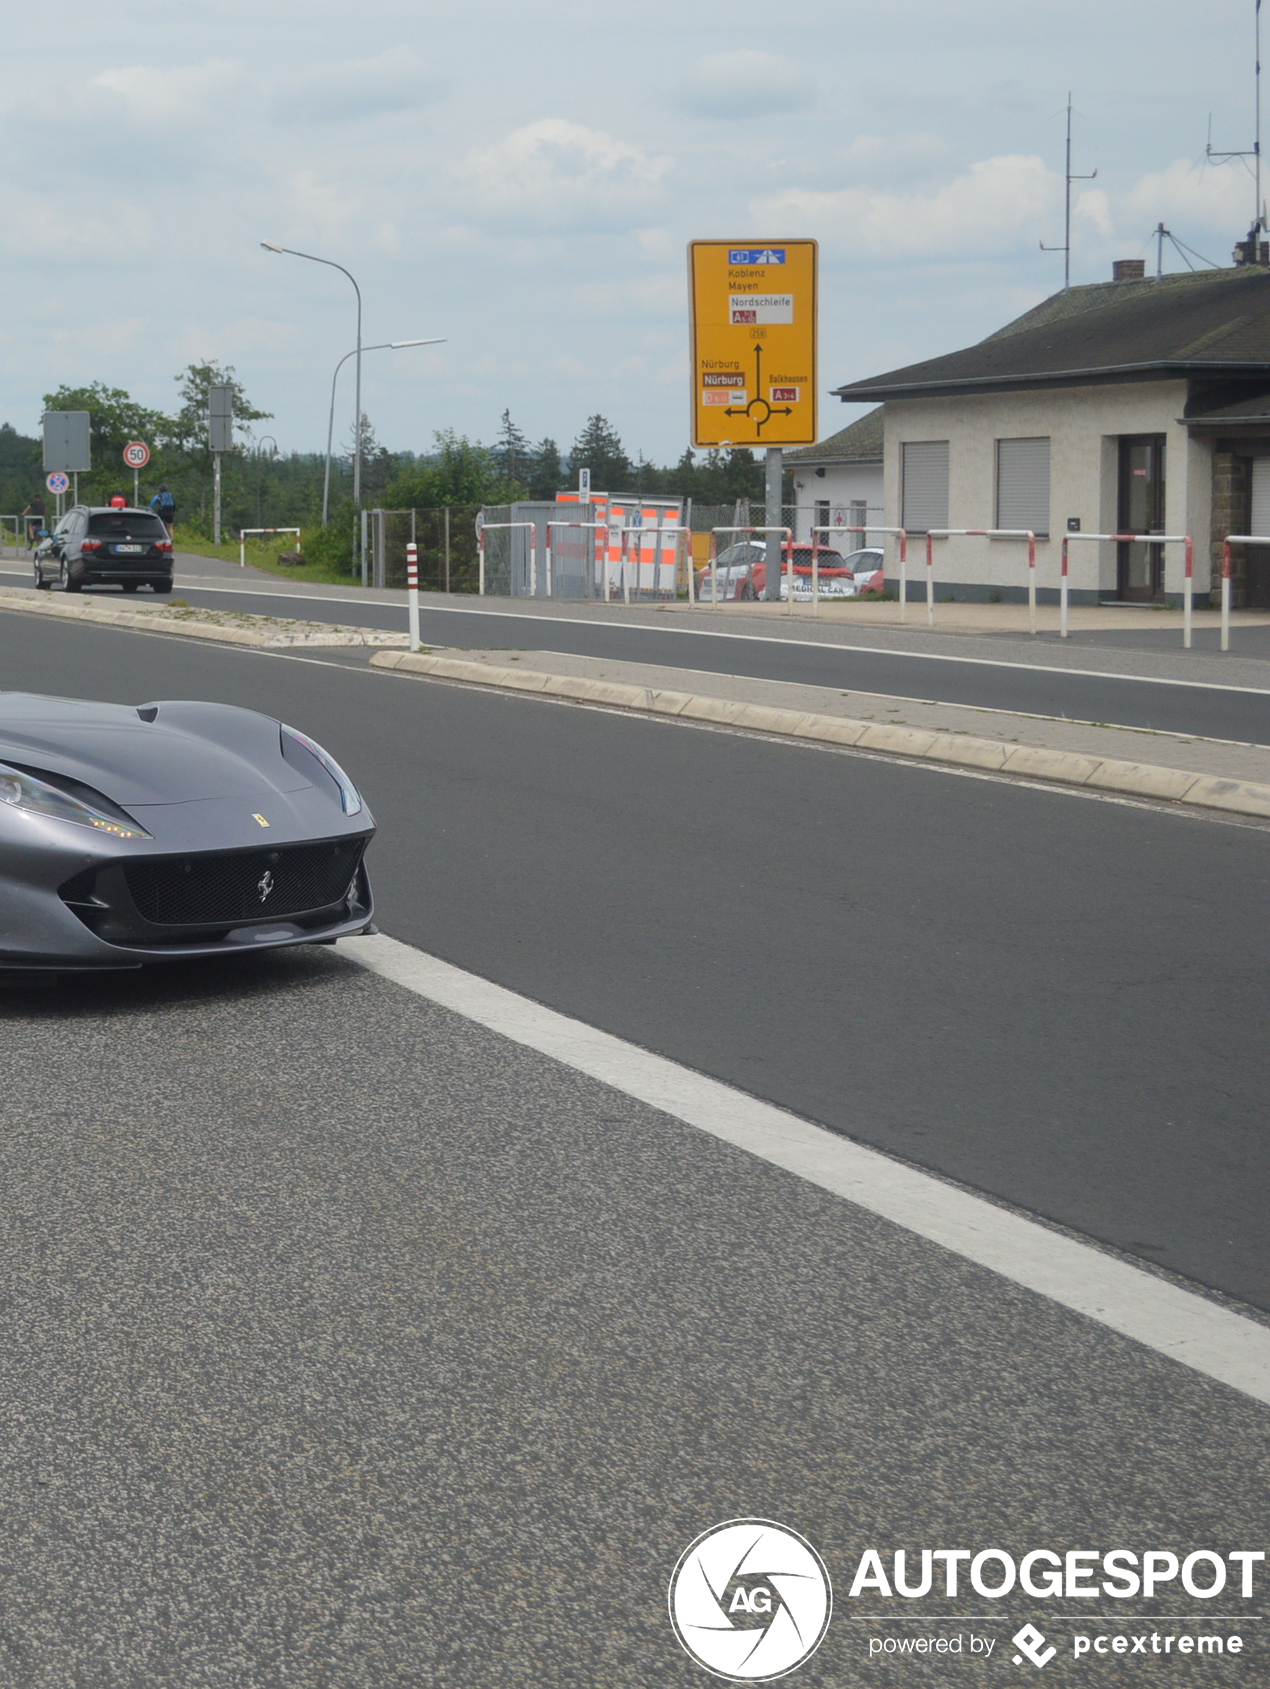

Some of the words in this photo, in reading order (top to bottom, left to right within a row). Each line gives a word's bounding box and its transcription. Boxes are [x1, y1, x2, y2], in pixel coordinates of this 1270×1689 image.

[728, 269, 765, 278] Koblenz
[728, 282, 759, 292] Mayen
[732, 297, 791, 306] Nordschleife
[734, 311, 742, 322] A
[702, 360, 739, 370] Nürburg
[704, 374, 743, 386] Nürburg
[769, 374, 808, 383] Balkhausen
[775, 390, 782, 399] A
[130, 449, 144, 460] 50
[828, 587, 845, 595] CAR
